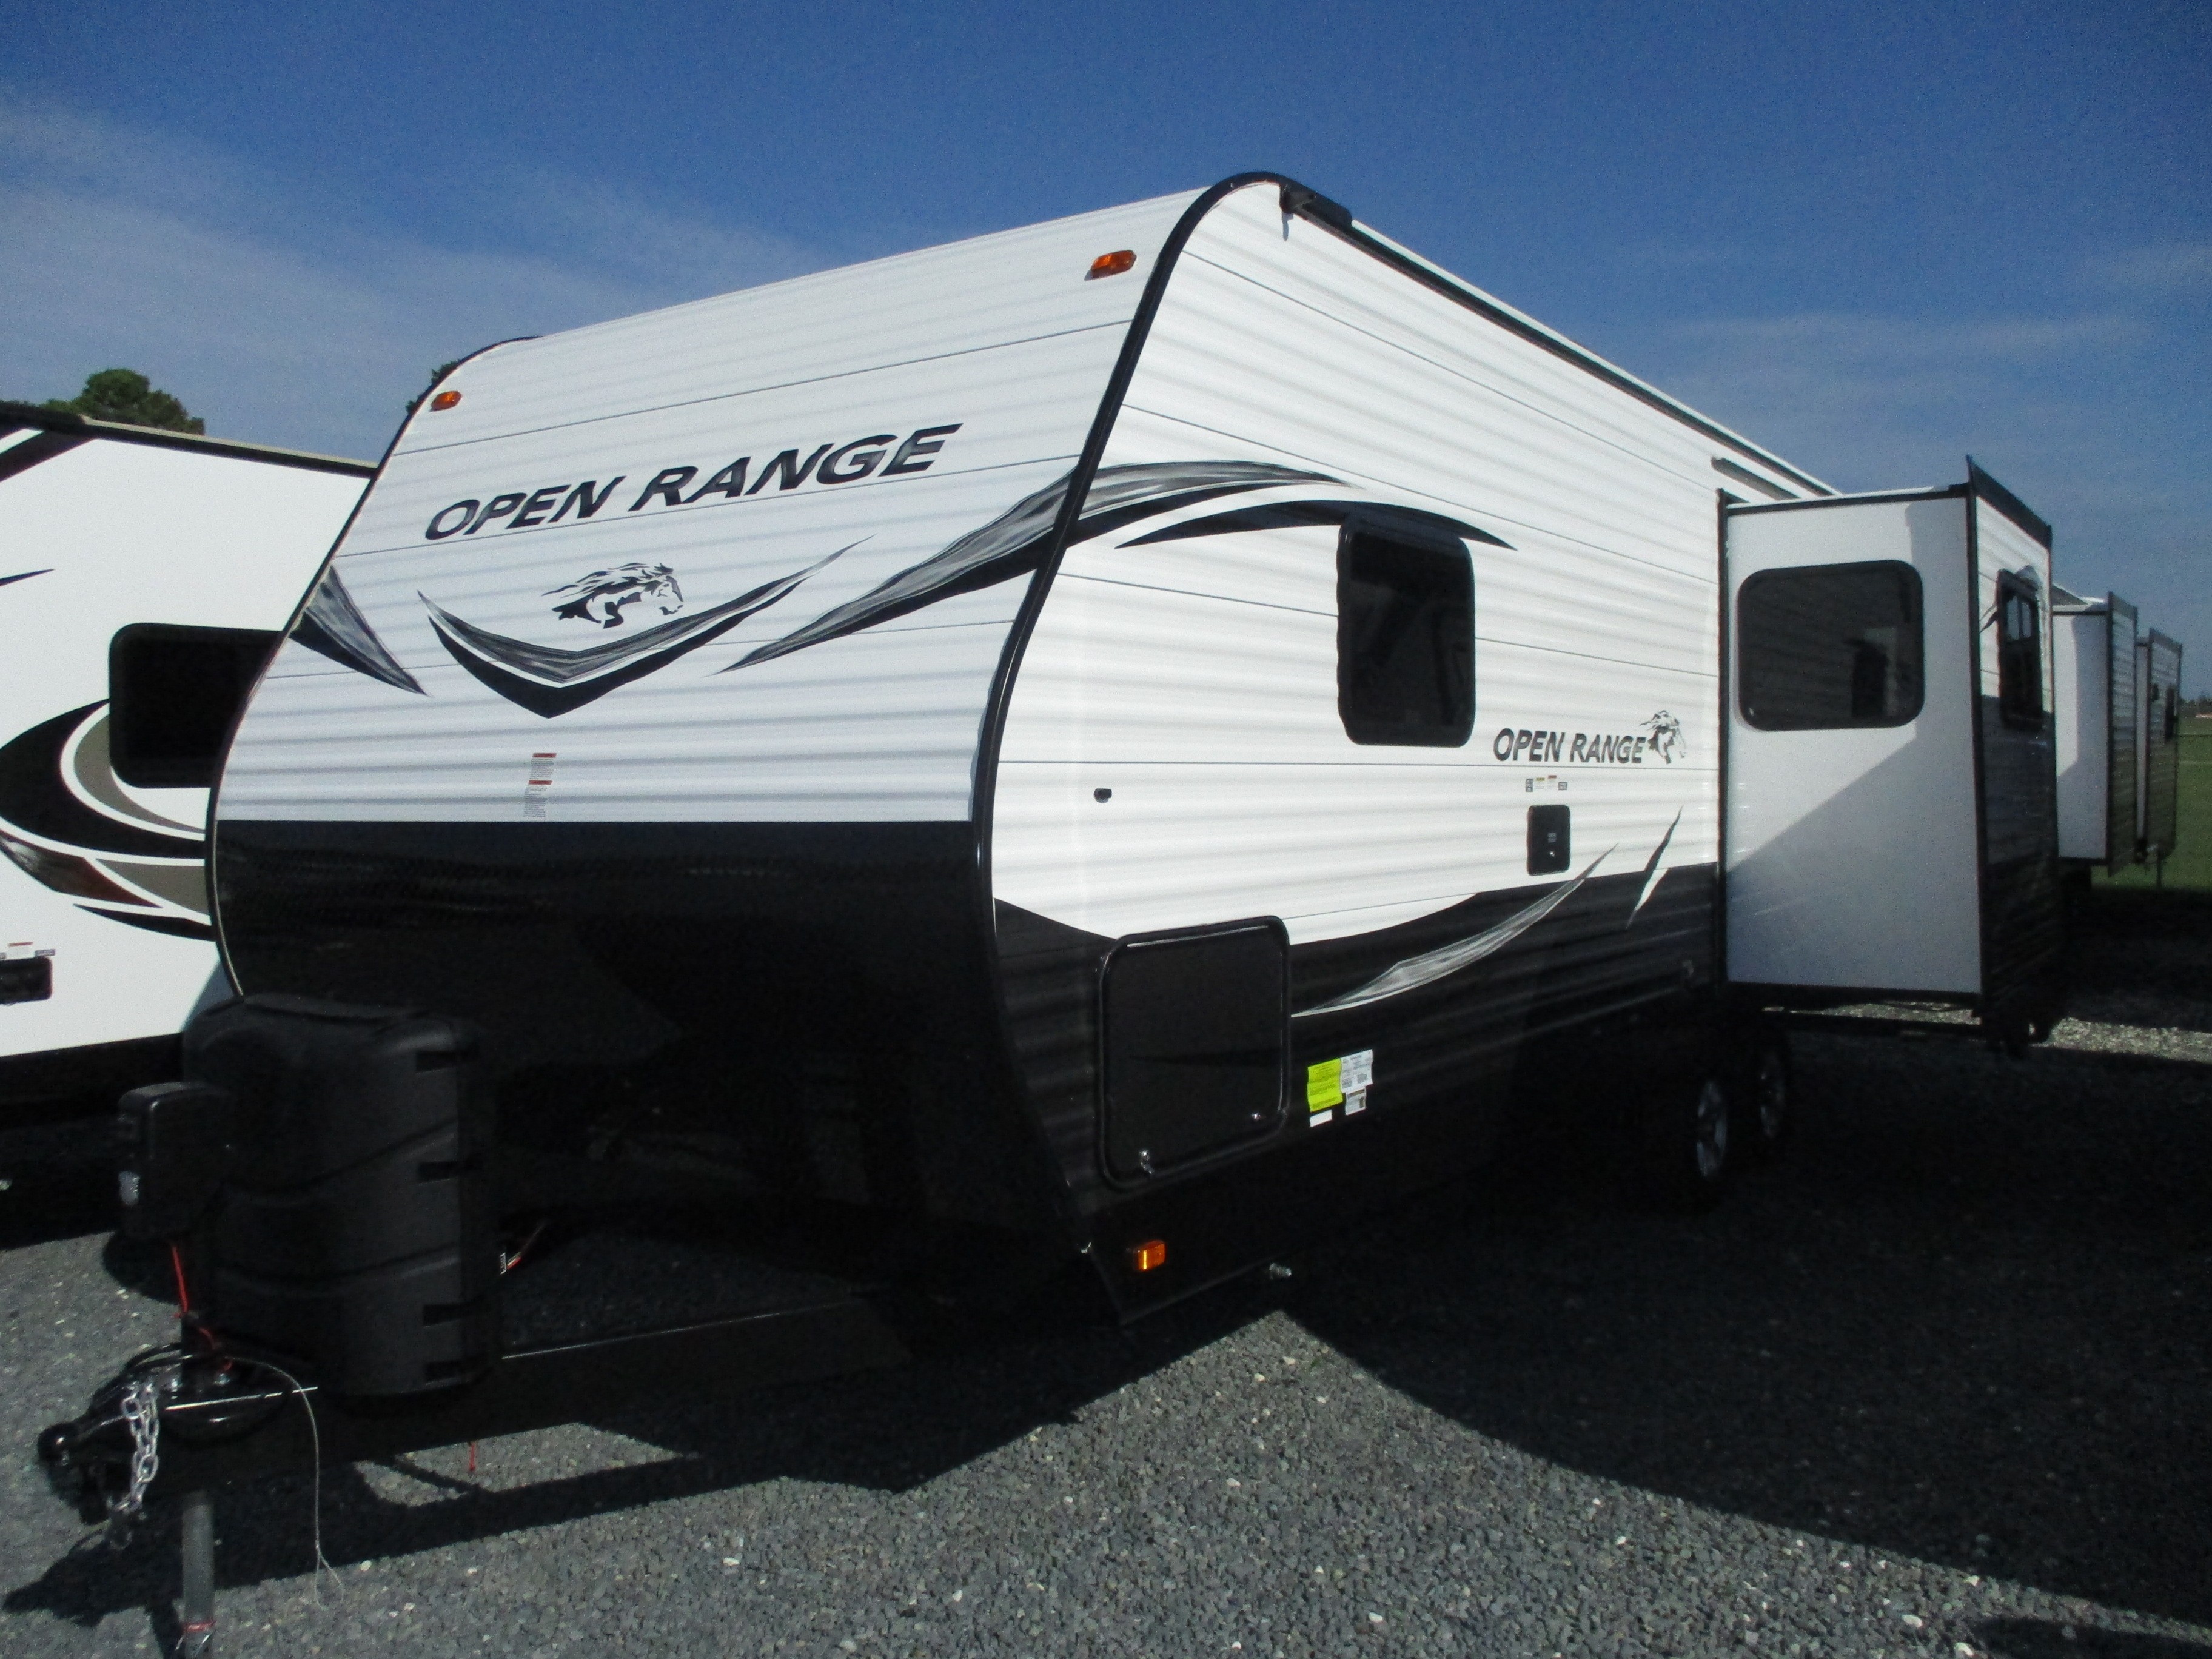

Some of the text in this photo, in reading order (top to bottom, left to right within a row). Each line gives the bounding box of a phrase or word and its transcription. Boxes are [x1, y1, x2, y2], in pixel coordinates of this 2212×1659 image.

[424, 423, 963, 540] OPEN RANGE
[1493, 728, 1647, 764] OPEN RANGE
